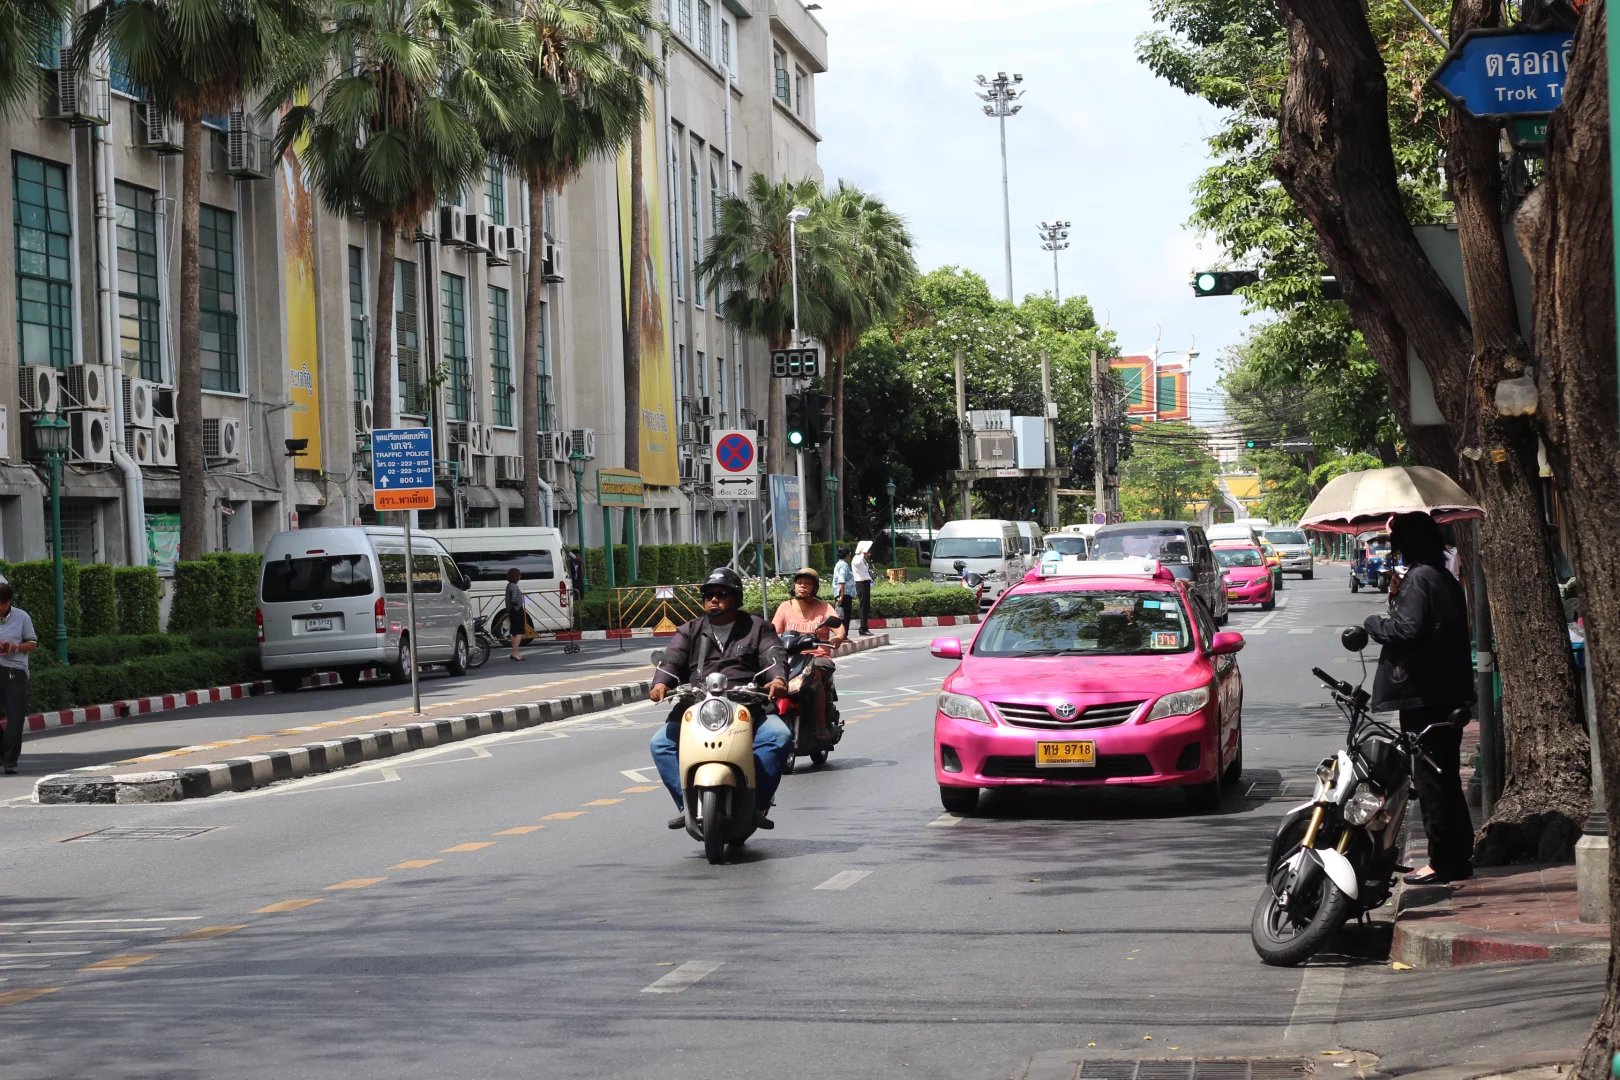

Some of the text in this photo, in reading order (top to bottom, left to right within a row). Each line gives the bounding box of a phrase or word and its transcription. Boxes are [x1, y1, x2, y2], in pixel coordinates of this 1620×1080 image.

[1495, 83, 1564, 102] Trok T
[1064, 744, 1091, 755] 9718
